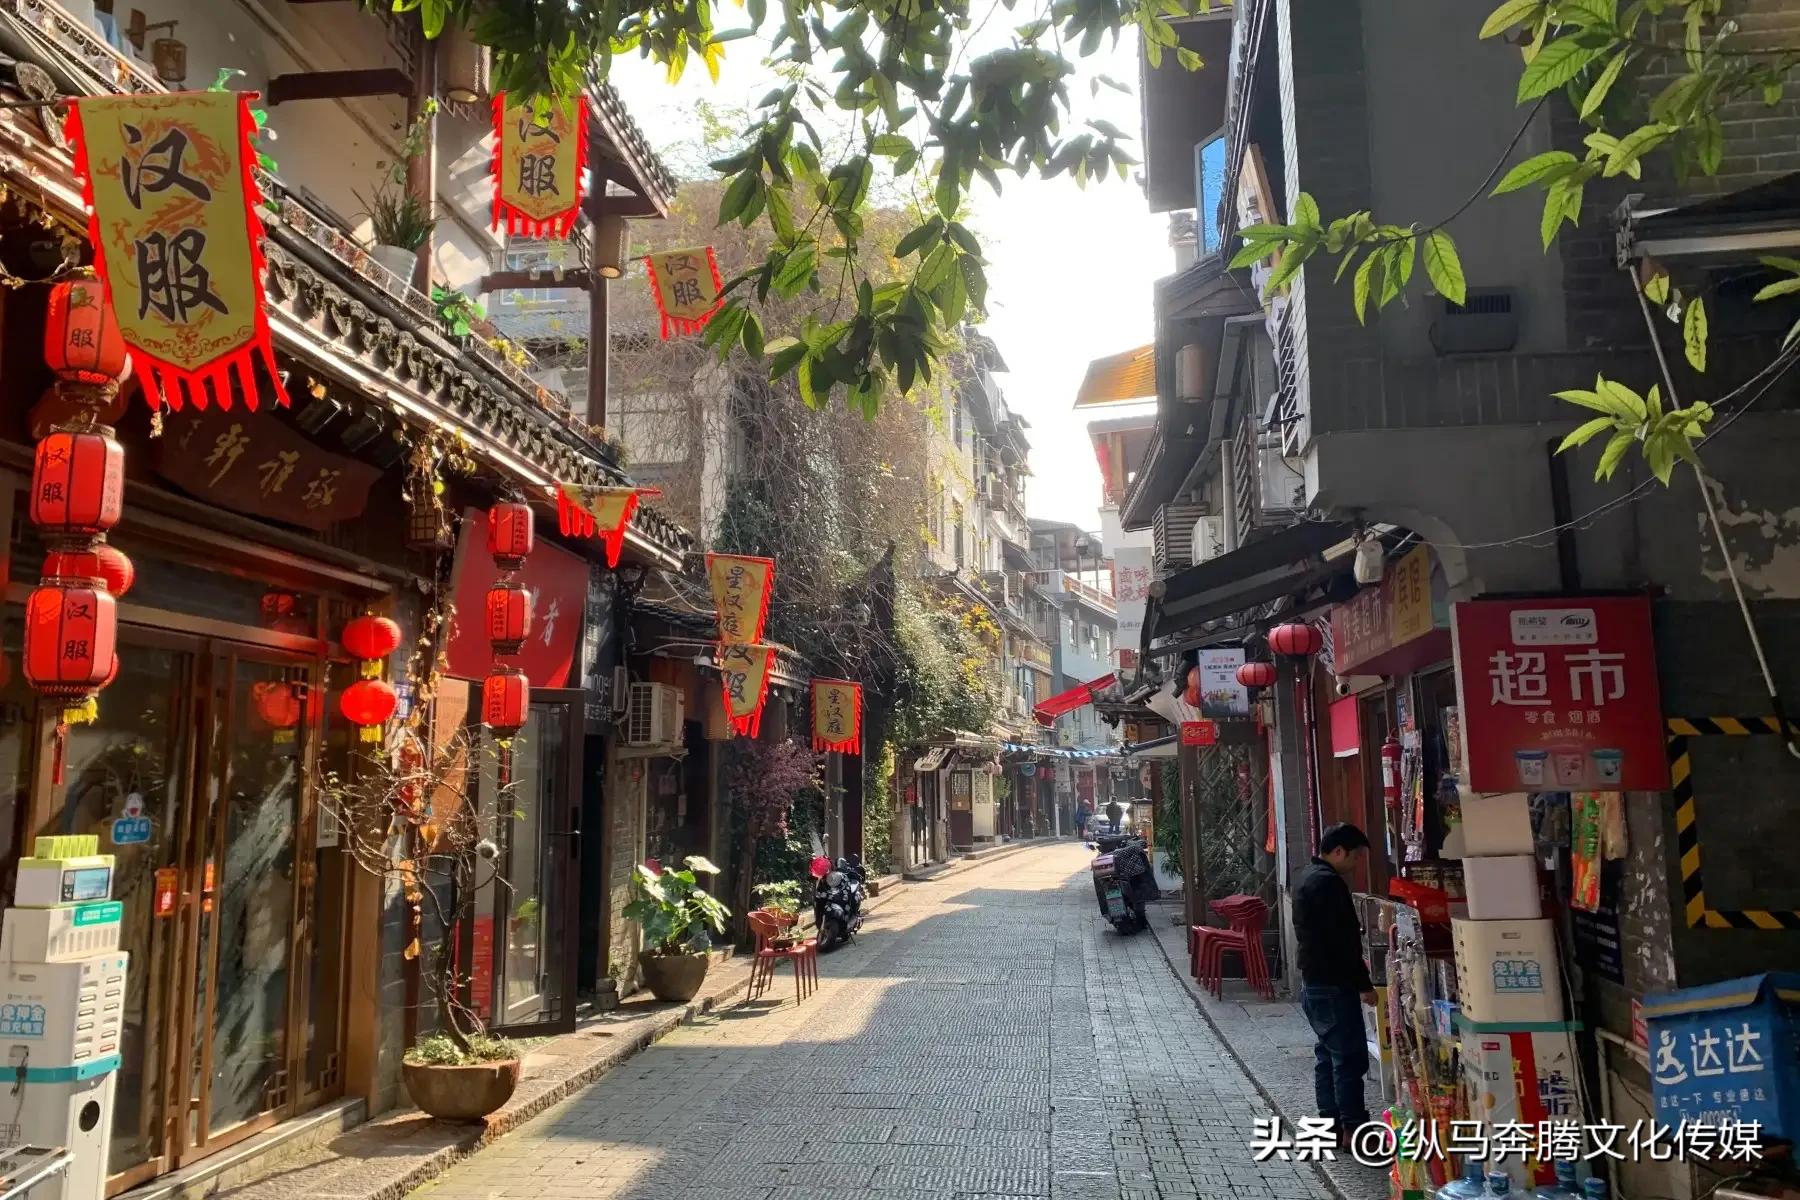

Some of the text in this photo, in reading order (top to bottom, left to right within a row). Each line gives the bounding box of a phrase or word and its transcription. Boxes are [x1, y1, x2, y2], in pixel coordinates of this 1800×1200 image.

[517, 105, 560, 197] 汉服
[121, 123, 229, 324] 汉服
[665, 255, 706, 306] 汉服
[41, 447, 67, 503] 汉服
[63, 602, 92, 661] 汉服
[1489, 649, 1625, 706] 超市
[1524, 710, 1601, 724] 零食 烟酒
[1690, 1023, 1764, 1077] 达达
